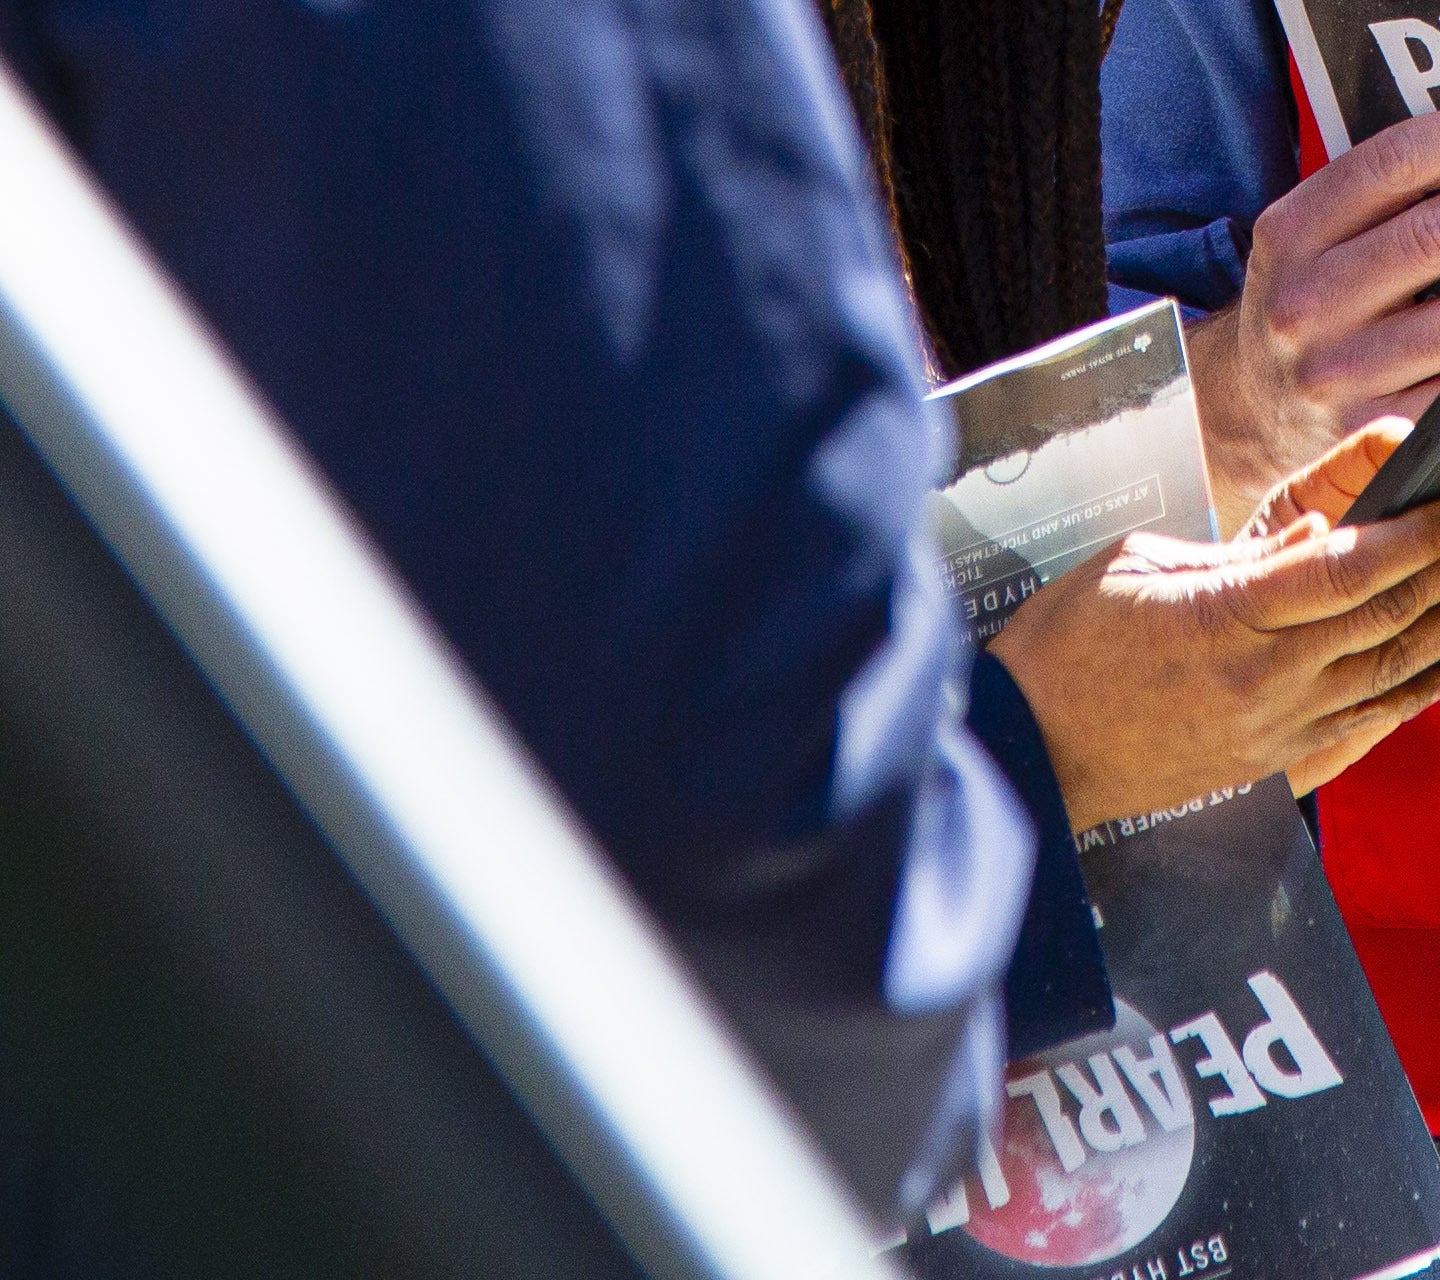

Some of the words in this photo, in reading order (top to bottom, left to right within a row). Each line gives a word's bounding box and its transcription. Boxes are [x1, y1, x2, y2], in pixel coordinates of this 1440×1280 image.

[1135, 483, 1149, 502] AT
[1032, 521, 1060, 541] AND
[1006, 969, 1345, 1173] PEARL
[1179, 1232, 1228, 1277] BST
